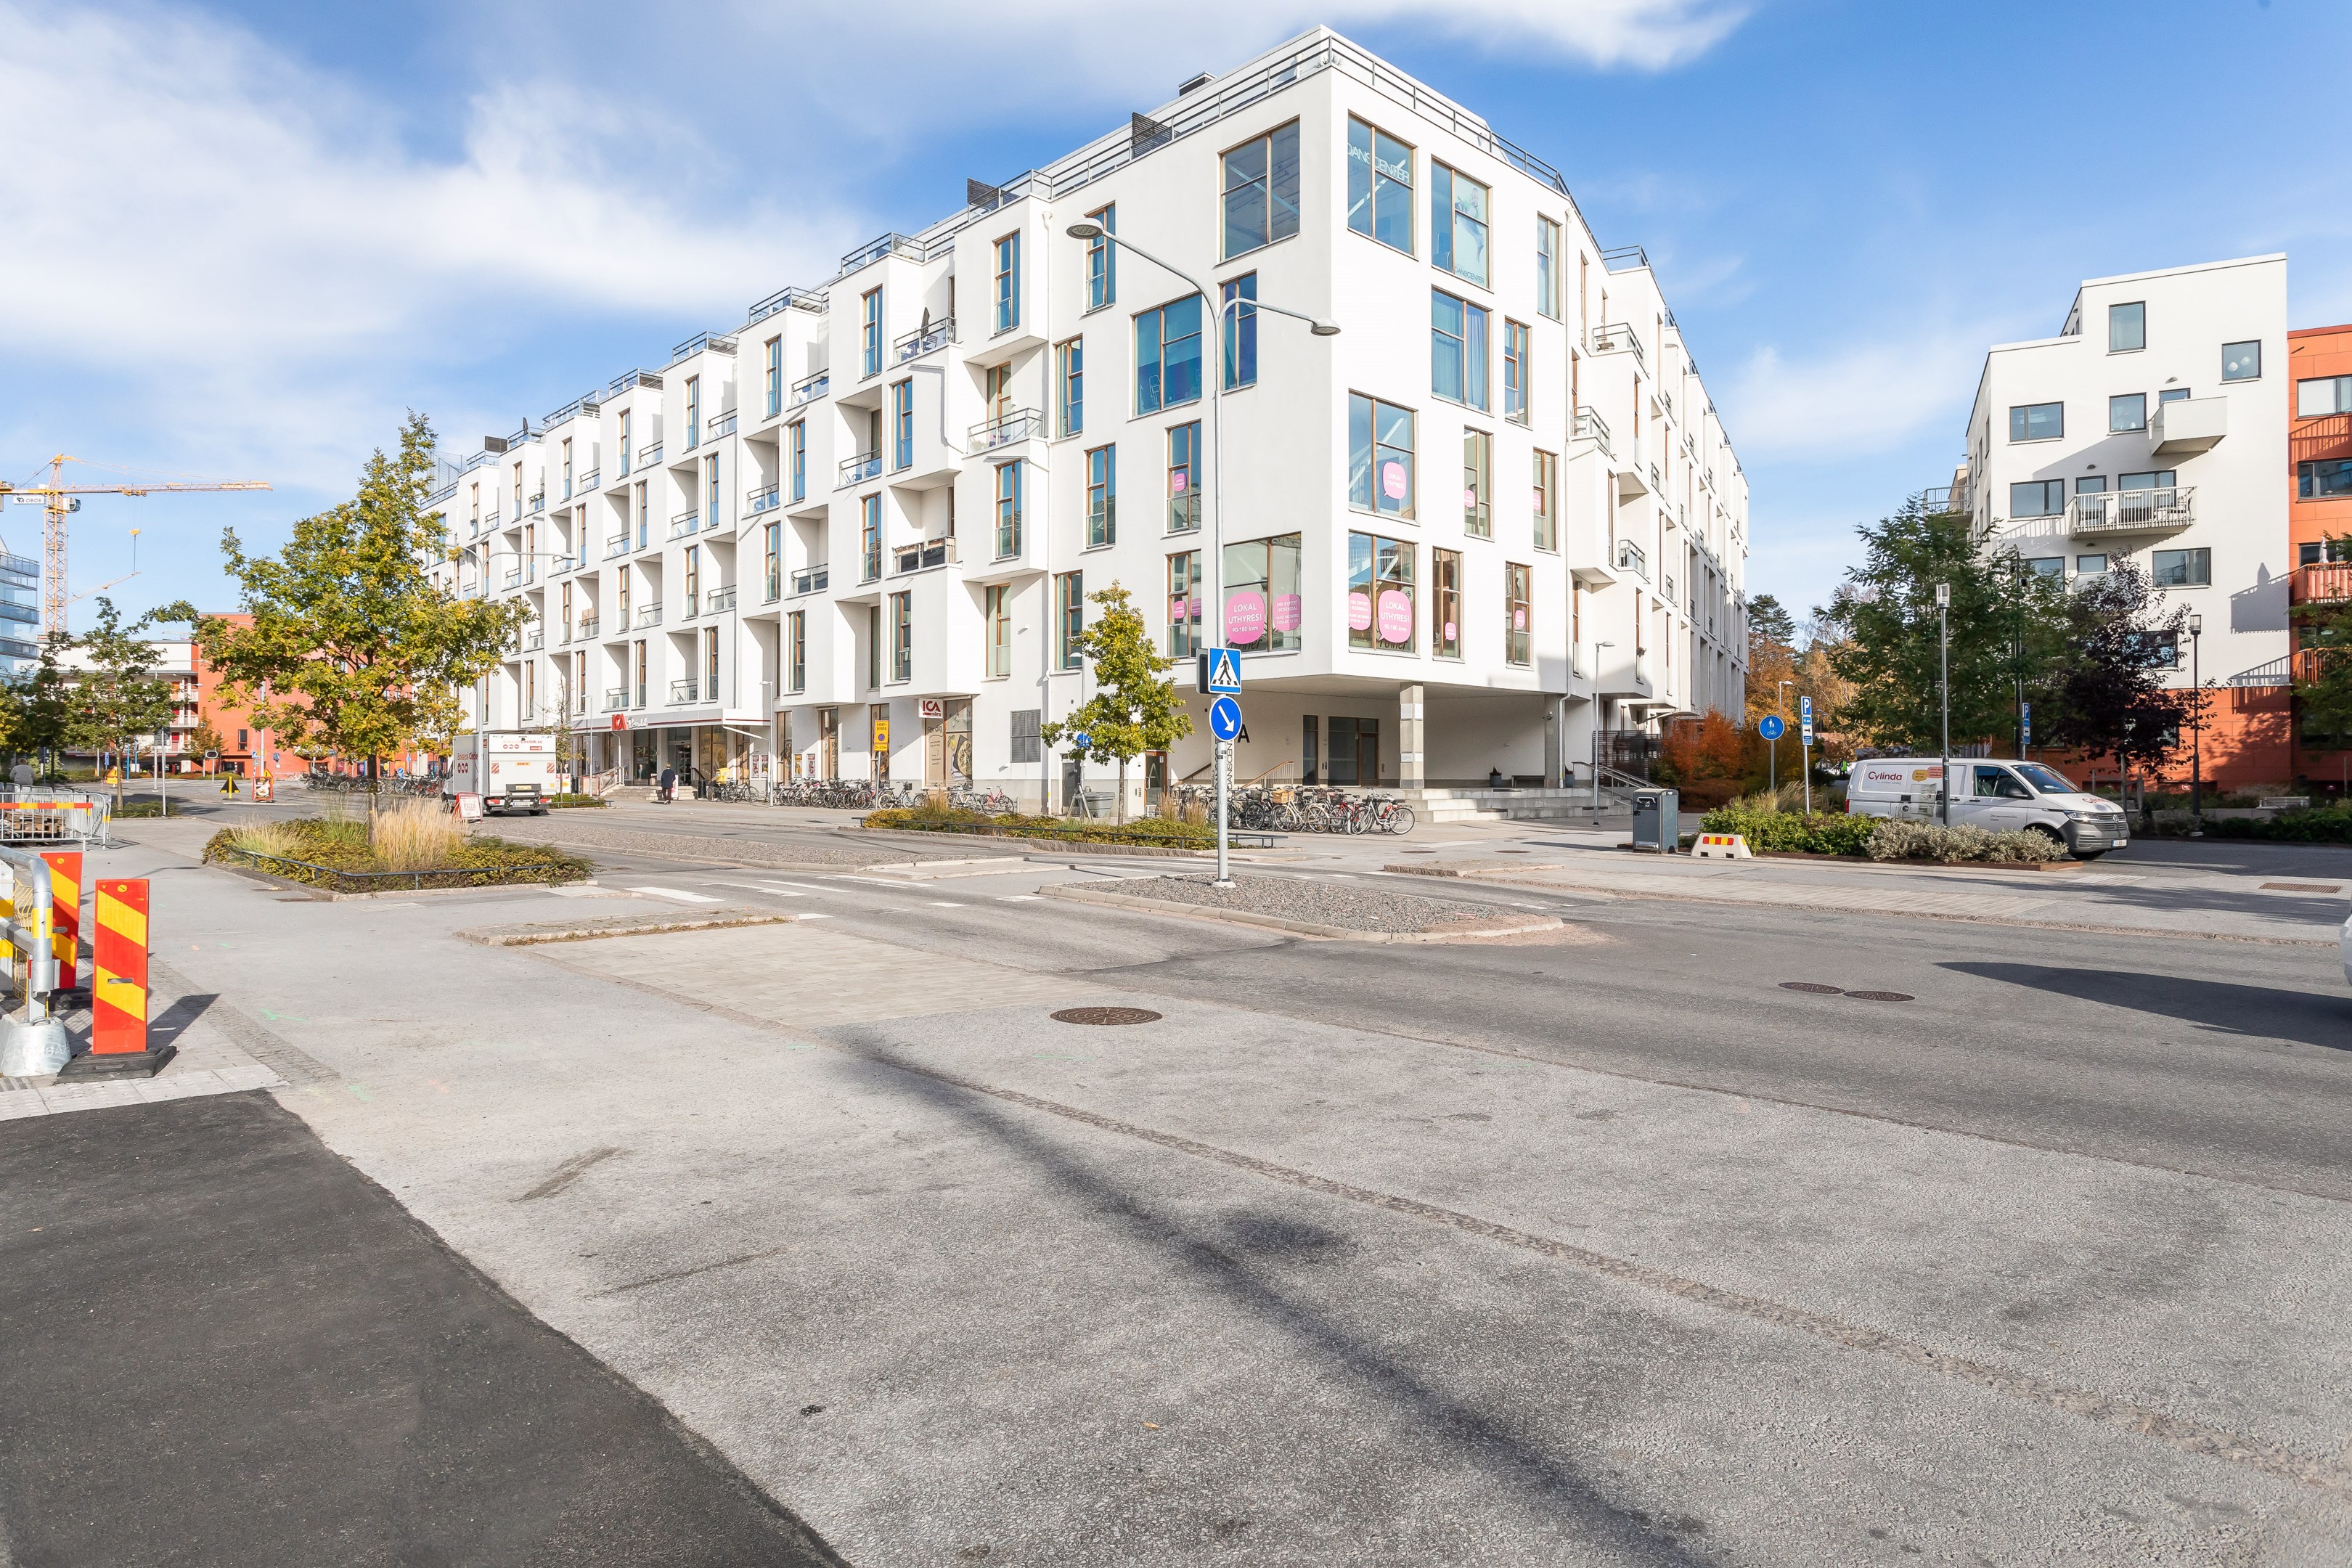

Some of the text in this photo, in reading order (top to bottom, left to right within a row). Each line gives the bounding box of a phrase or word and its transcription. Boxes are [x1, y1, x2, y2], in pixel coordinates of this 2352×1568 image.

[1234, 603, 1257, 613] LOKAL
[1386, 602, 1405, 611] LOKAL
[1228, 613, 1262, 624] UTHYRES!
[1381, 611, 1410, 623] UTHYRES!
[922, 700, 942, 712] ICA
[1804, 698, 1810, 714] P
[1238, 724, 1250, 743] A
[1868, 771, 1903, 781] Cylinda
